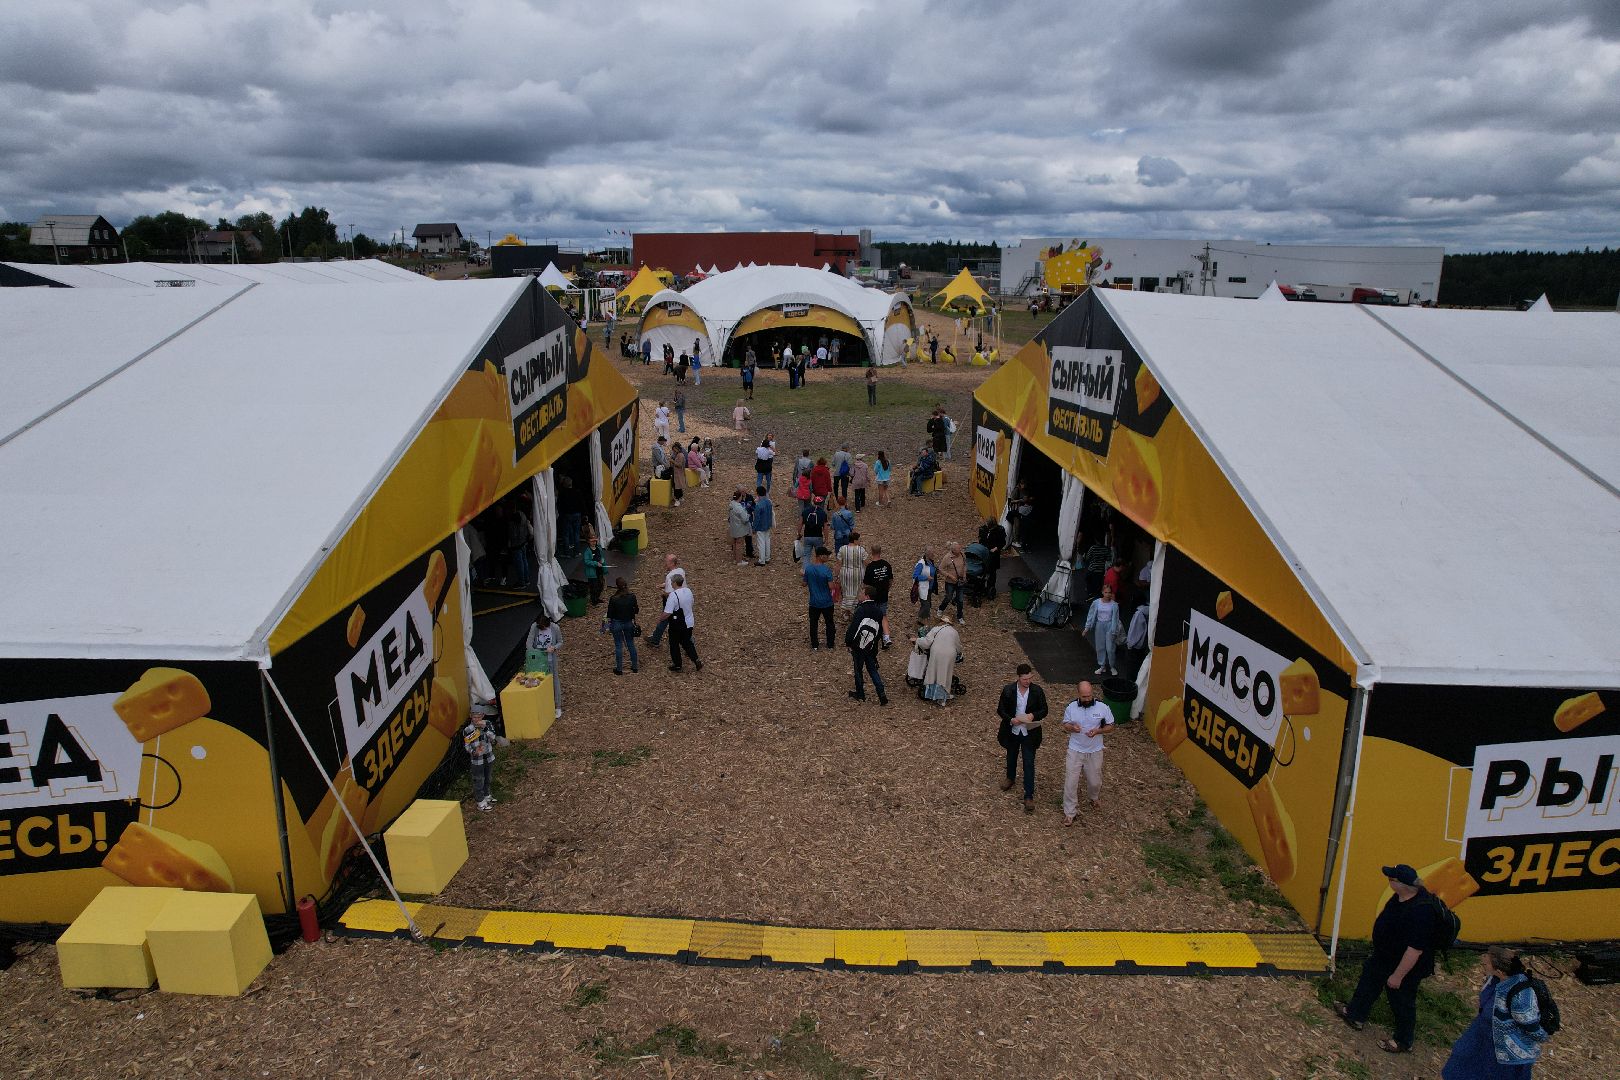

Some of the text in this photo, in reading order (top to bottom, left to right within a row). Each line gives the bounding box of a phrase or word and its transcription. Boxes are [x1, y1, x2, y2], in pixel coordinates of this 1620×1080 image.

[1051, 355, 1114, 401] СЫРНЫЙ
[613, 427, 630, 467] СЫР
[977, 433, 996, 462] ПИВО
[1052, 406, 1103, 443] ФЕСТИВАЛЬ
[350, 609, 424, 728] МЕД
[1190, 626, 1276, 717] МЯСО
[363, 678, 429, 789] ЗДЕСЬ!
[1187, 698, 1260, 778] ЗДЕСЬ!
[1480, 754, 1620, 810] РЫ
